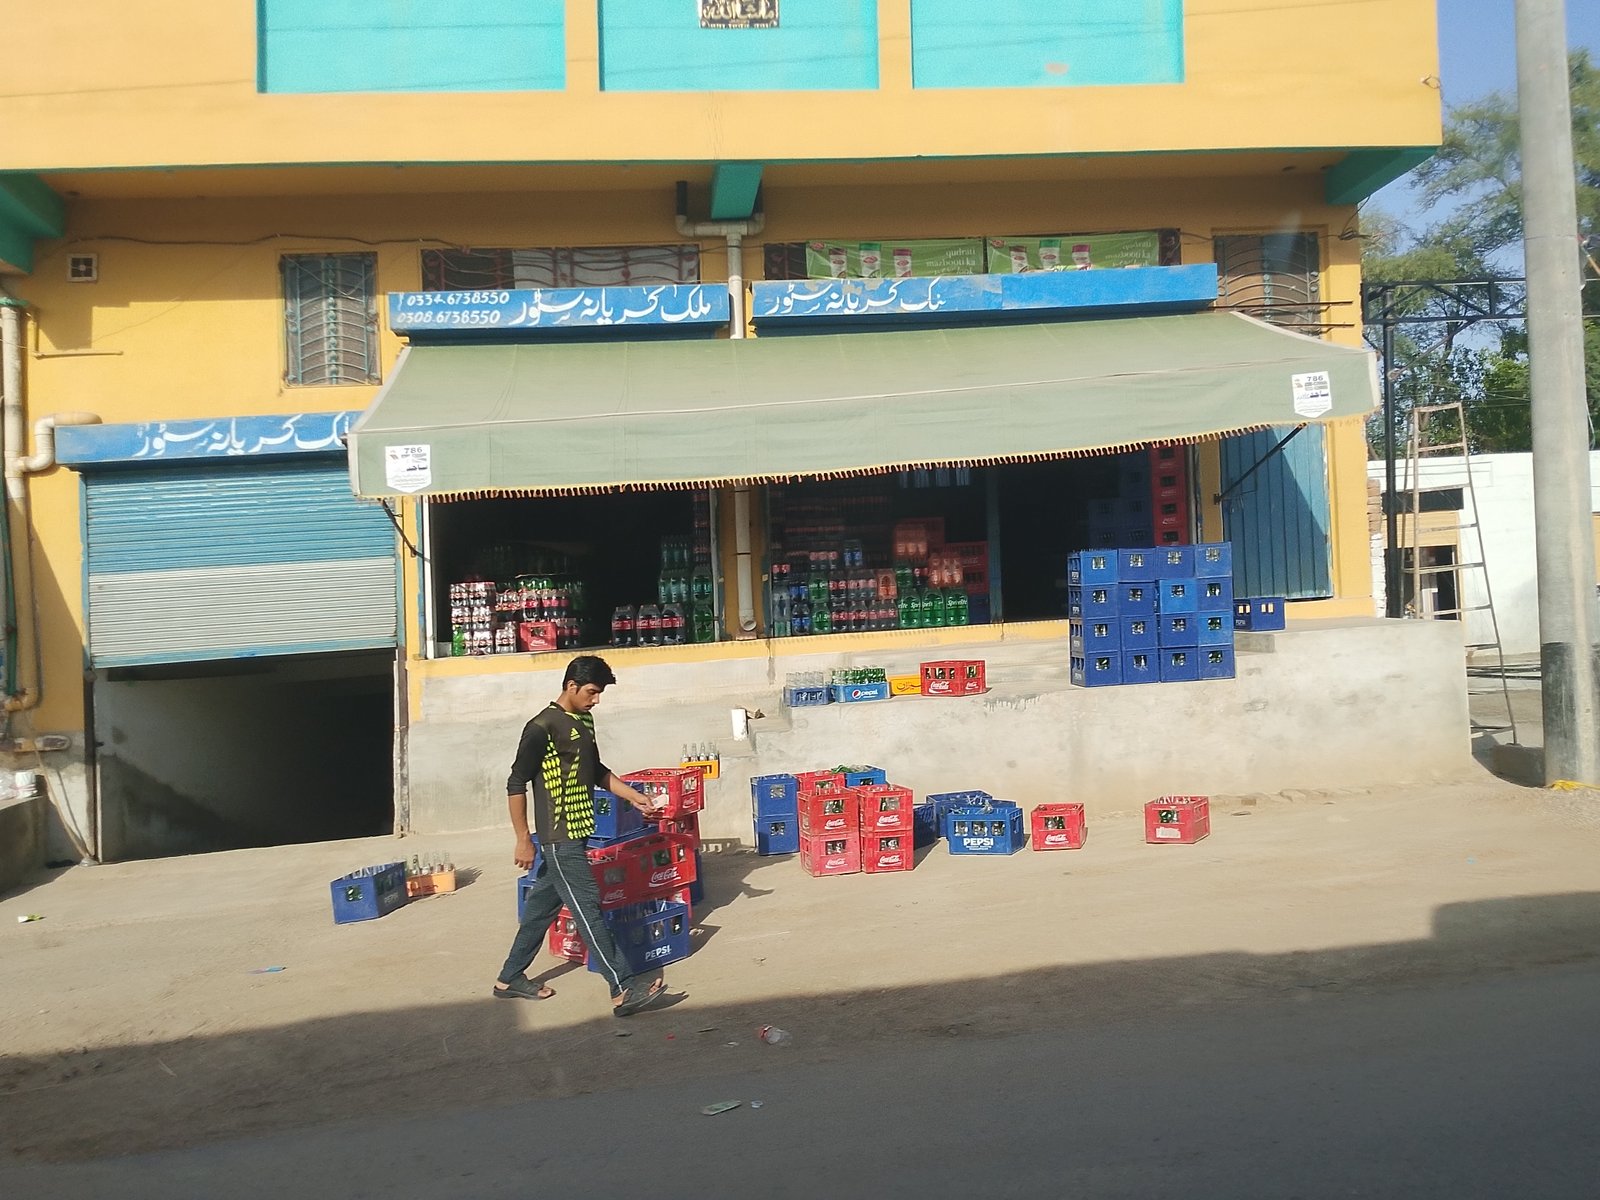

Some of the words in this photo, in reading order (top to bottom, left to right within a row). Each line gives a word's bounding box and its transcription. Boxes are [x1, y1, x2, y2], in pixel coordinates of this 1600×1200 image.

[293, 411, 350, 450] لک
[404, 446, 423, 454] 786
[878, 814, 900, 825] Coca-Cola
[963, 838, 994, 846] PEPSI
[650, 867, 679, 885] Coca-Cola
[645, 945, 671, 960] PEPSI
